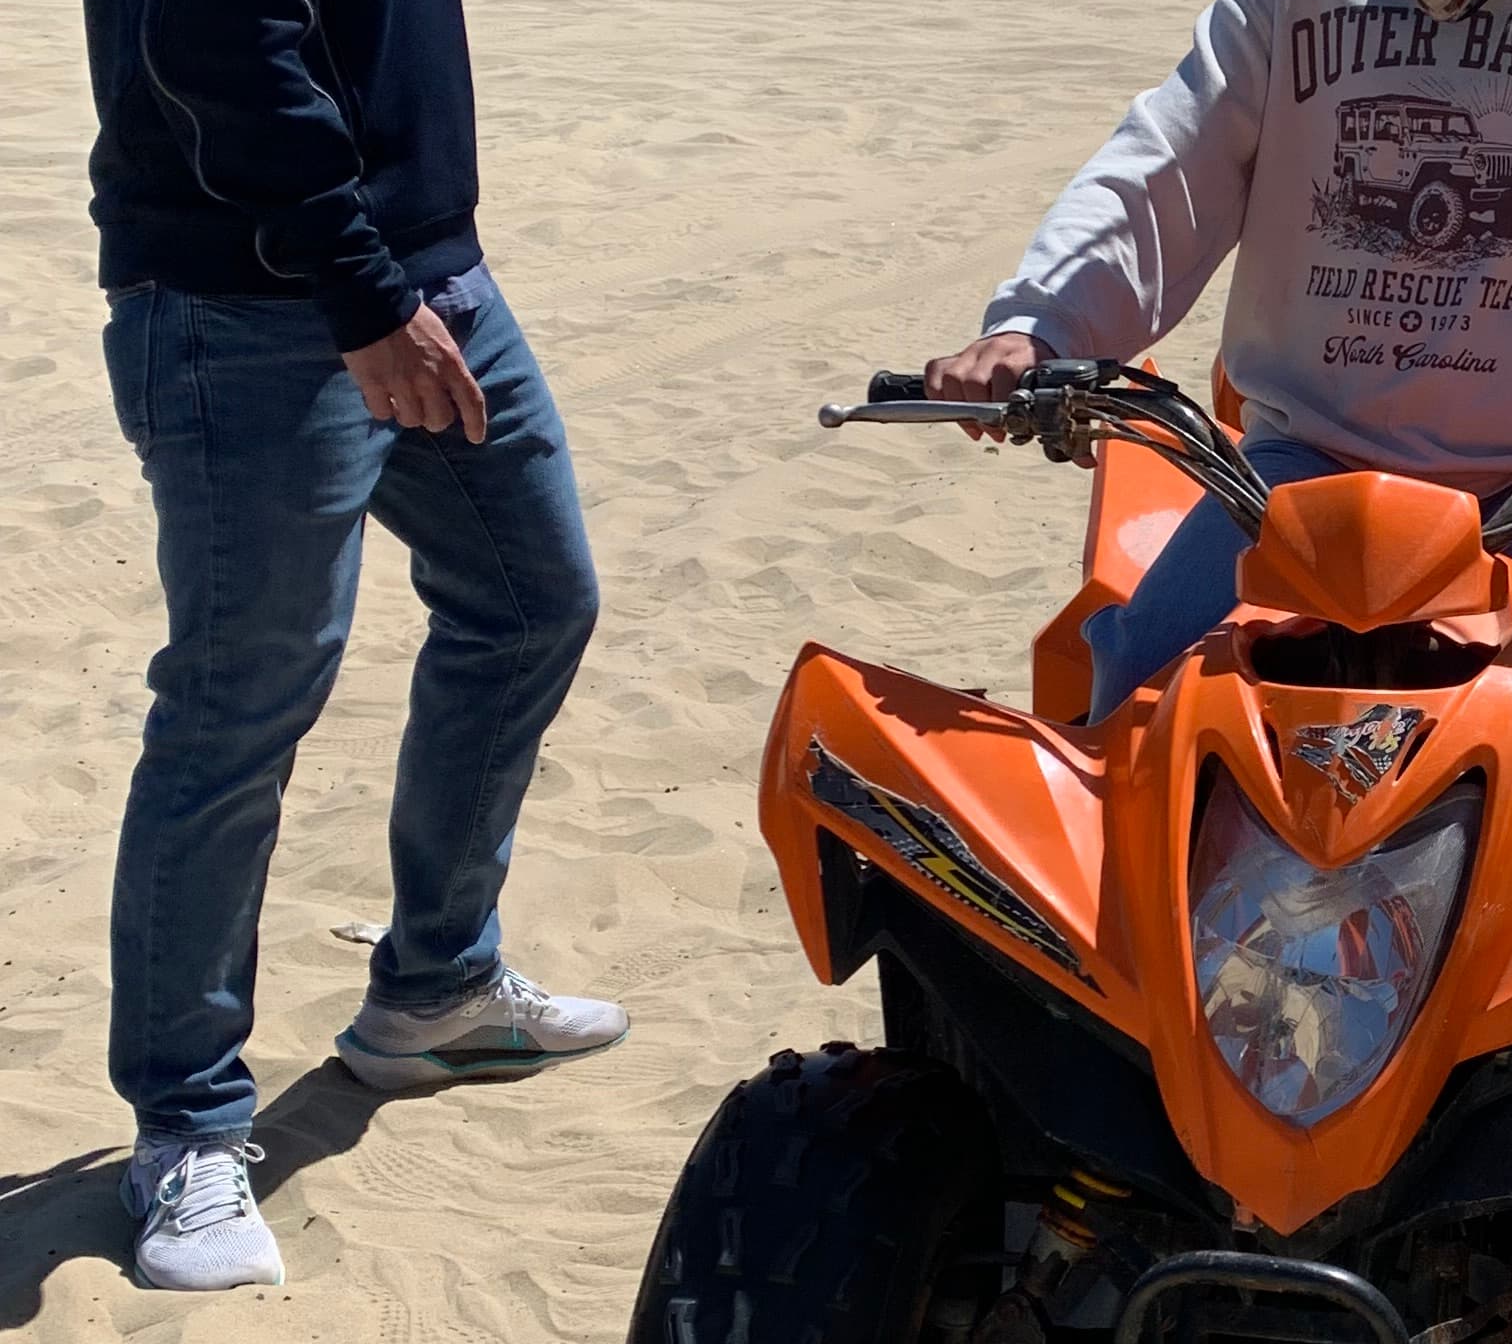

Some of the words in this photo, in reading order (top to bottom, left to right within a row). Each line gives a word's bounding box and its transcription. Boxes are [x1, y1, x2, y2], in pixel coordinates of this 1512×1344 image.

[1291, 5, 1439, 103] OUTER
[1306, 265, 1357, 299] FIELD
[1360, 268, 1469, 307] RESCUE
[1347, 308, 1393, 327] SINCE
[1430, 314, 1471, 331] 1973
[1323, 335, 1385, 367] North
[1392, 342, 1498, 373] Carolina
